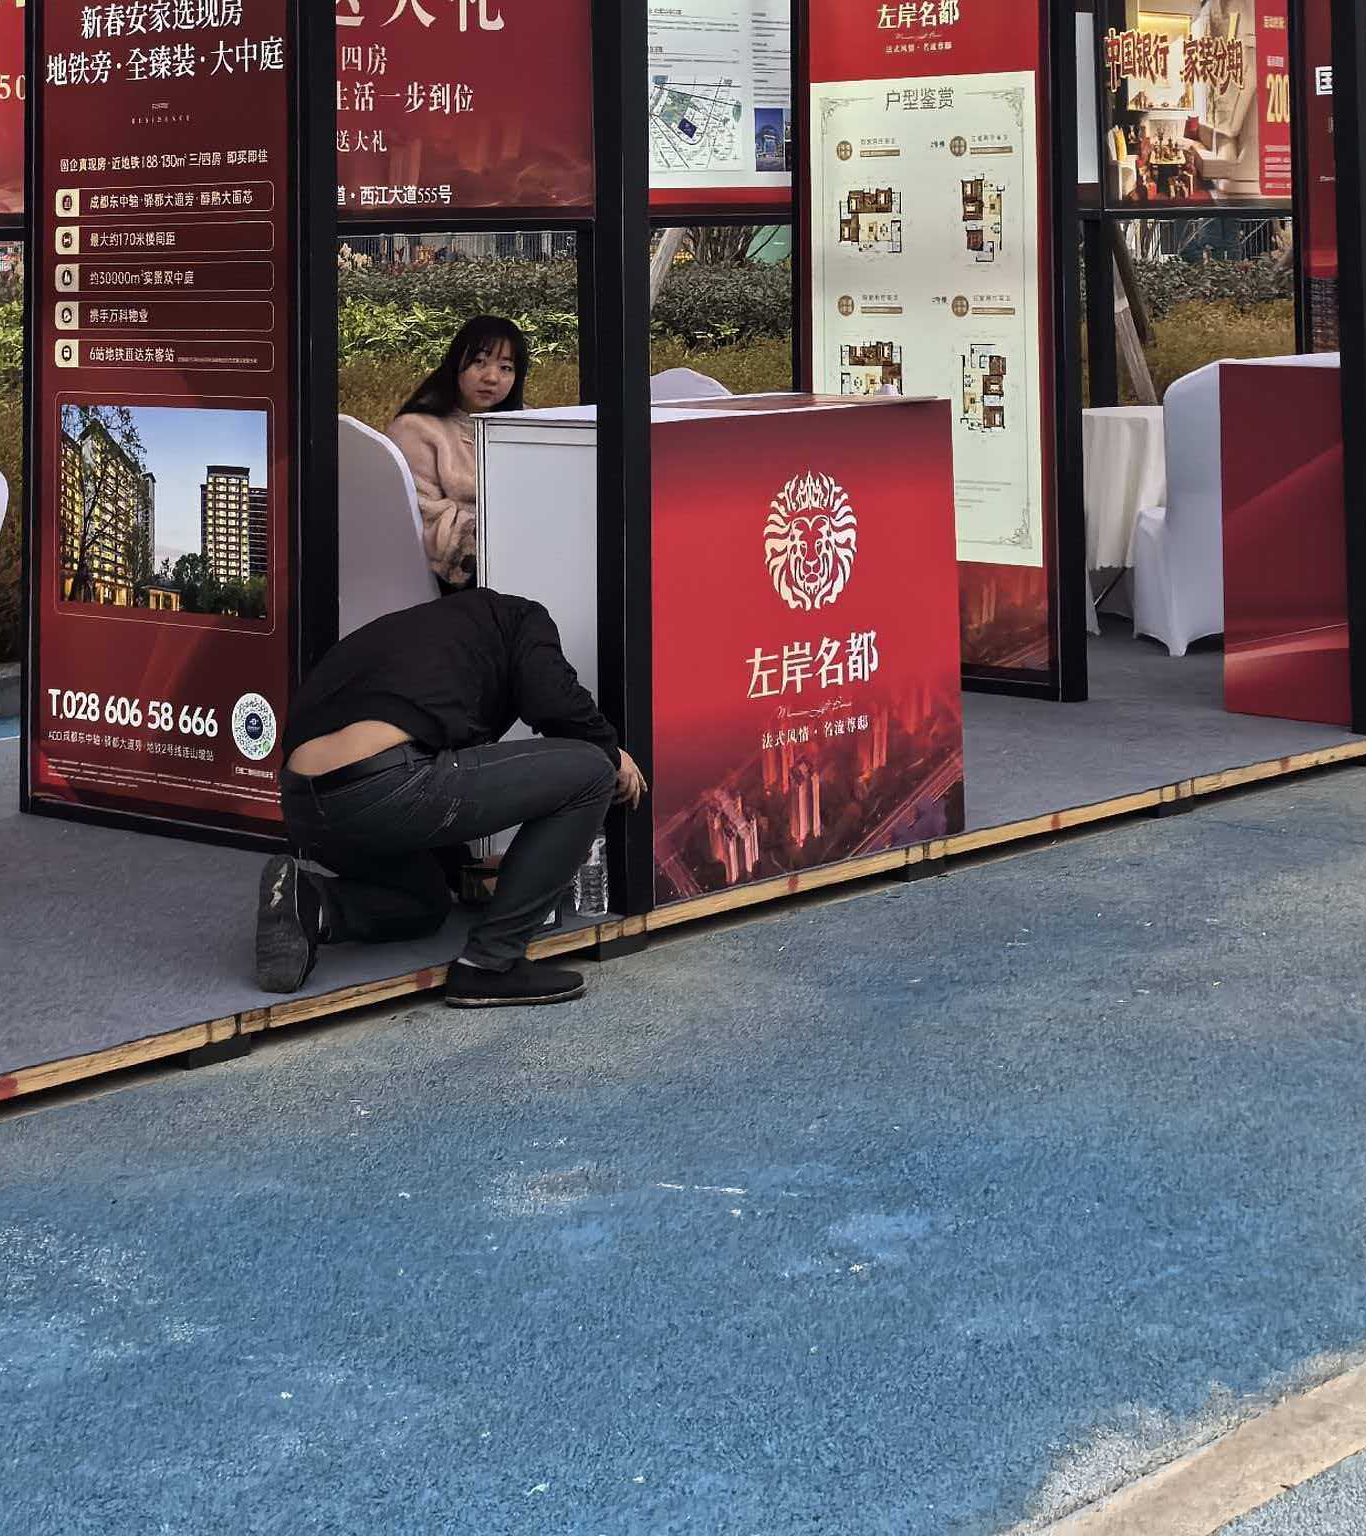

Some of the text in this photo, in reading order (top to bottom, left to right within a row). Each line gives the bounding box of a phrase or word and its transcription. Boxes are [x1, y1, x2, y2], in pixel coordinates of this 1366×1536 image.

[877, 0, 960, 29] 左岸名都
[45, 35, 285, 86] 地铁旁·全臻装·大中庭
[342, 44, 388, 75] 四房
[1104, 27, 1245, 96] 中国银行 家装分期
[336, 80, 474, 115] 生活一步到位
[885, 87, 954, 112] 户型鉴赏
[227, 148, 268, 164] 即买即住
[336, 129, 388, 153] 送大礼
[745, 630, 879, 700] 左岸名都
[48, 688, 218, 738] T.028 606 58 666
